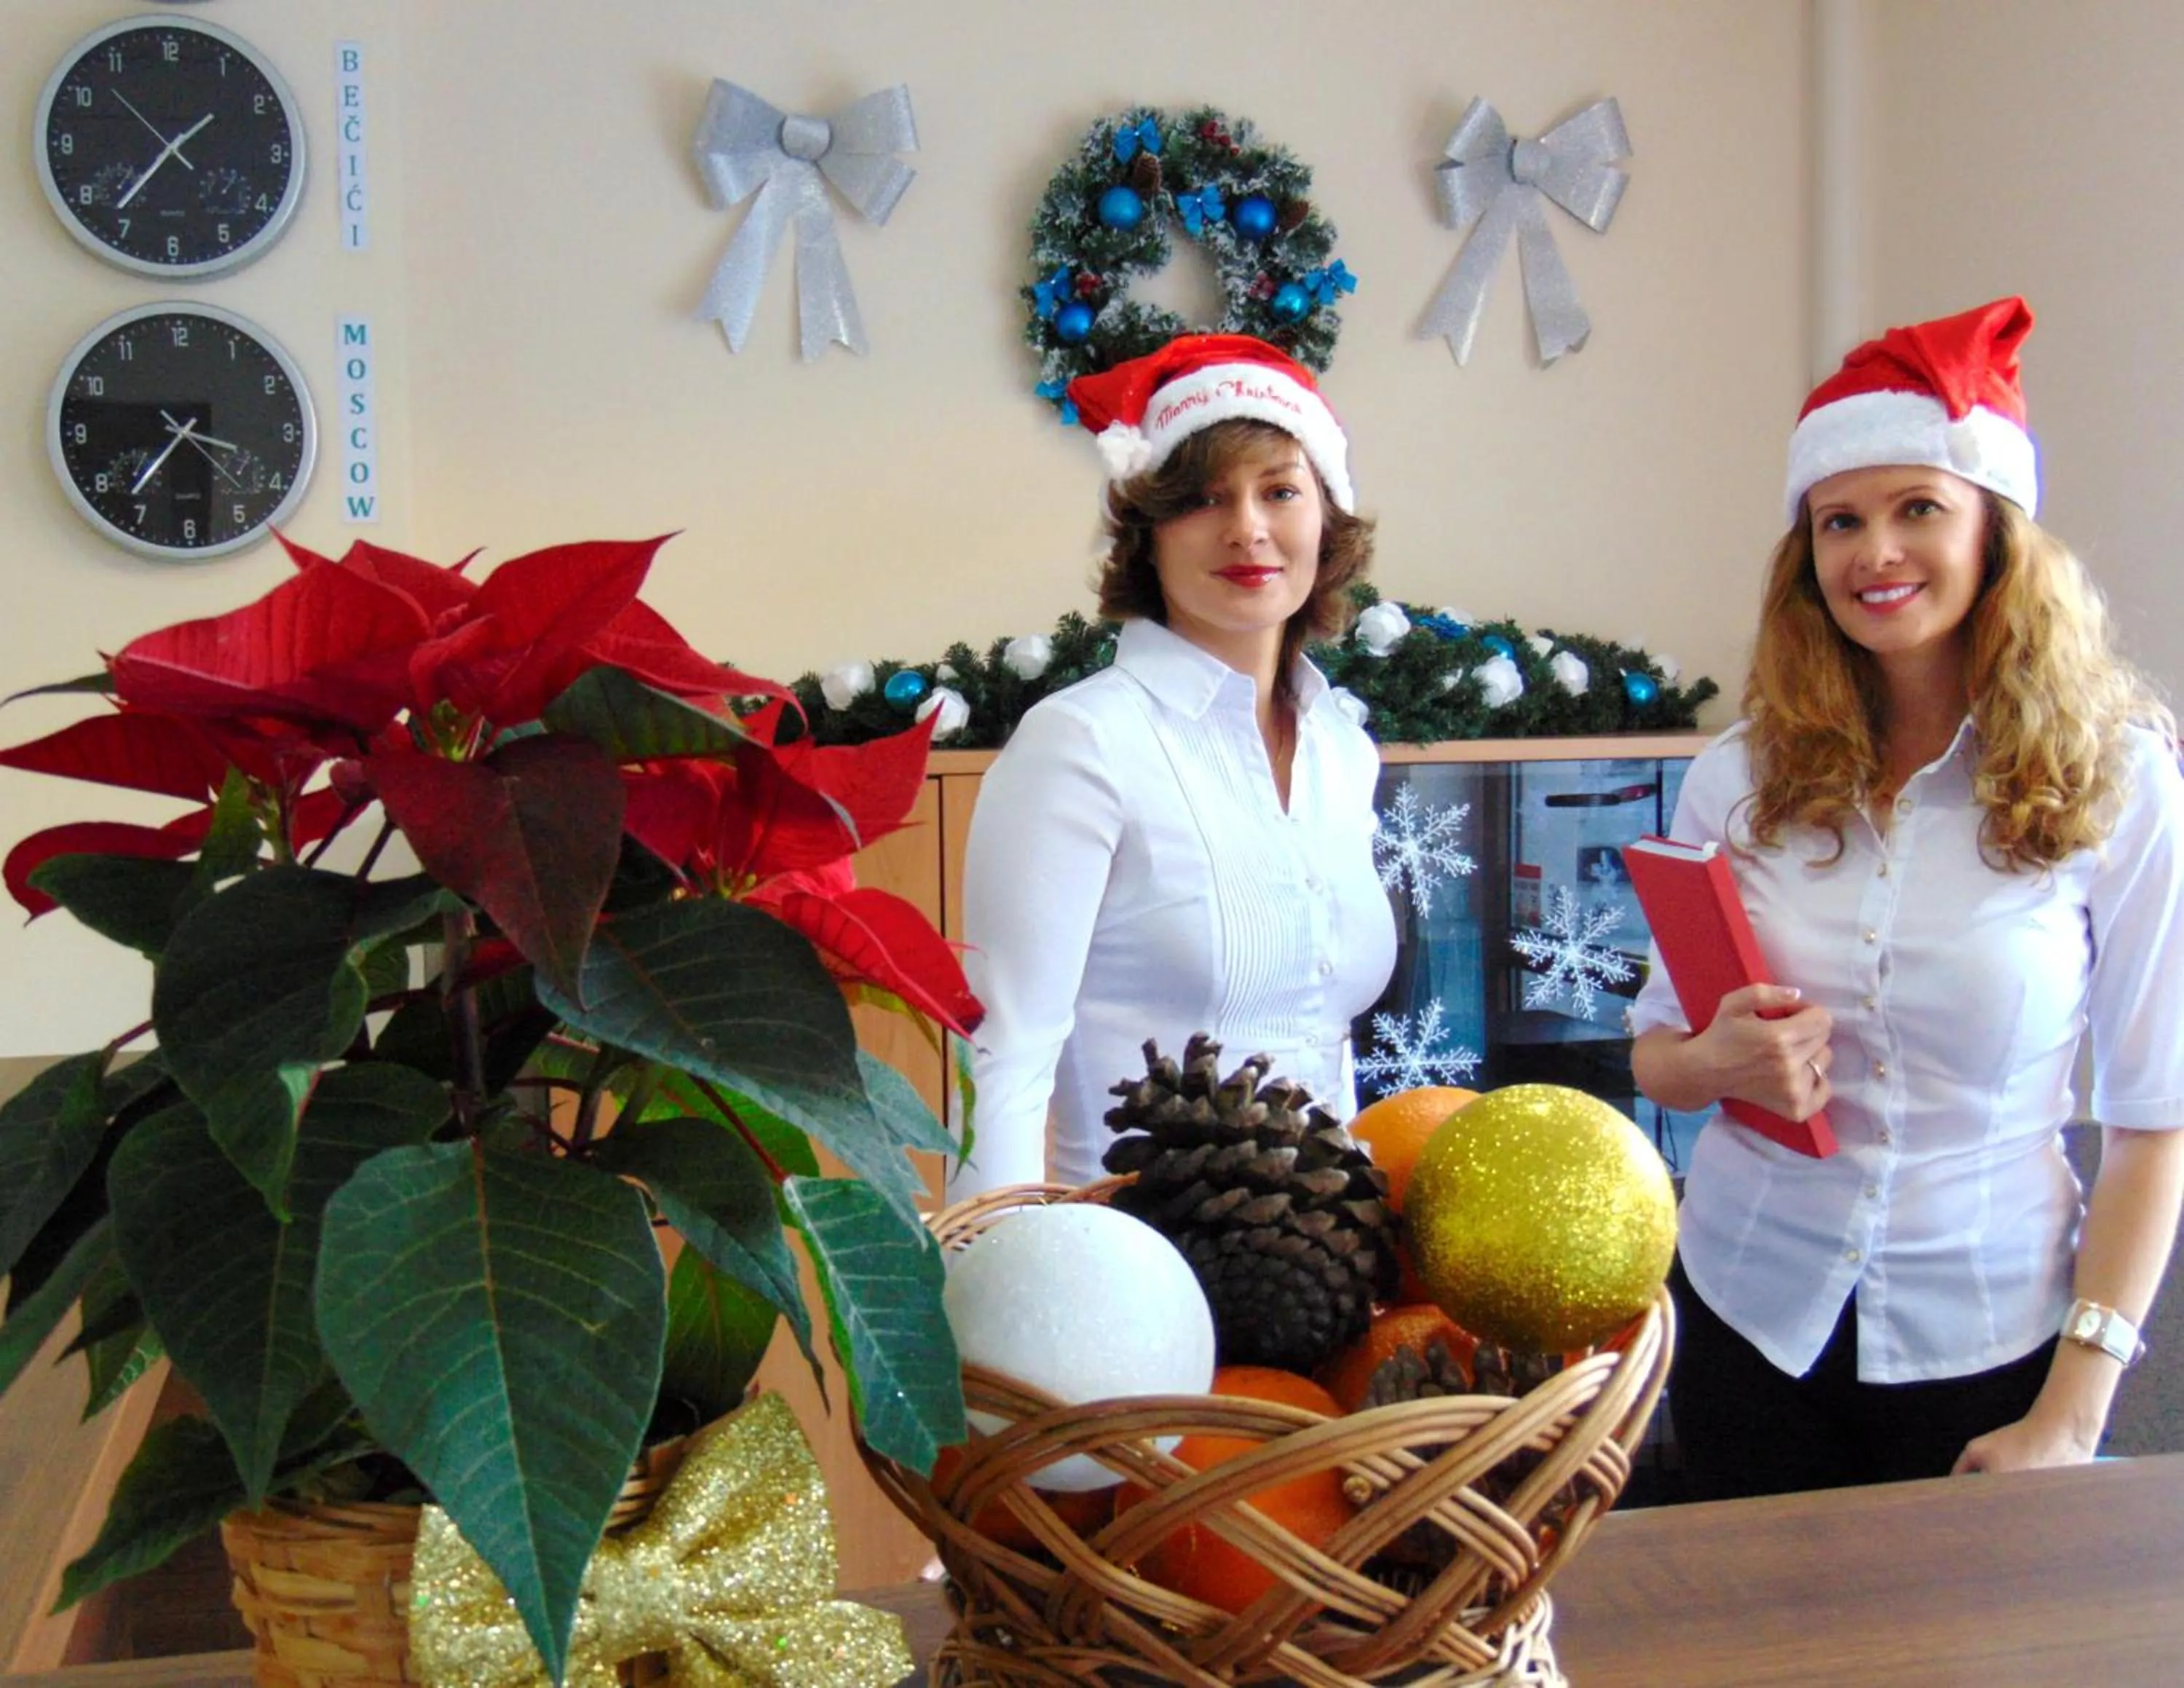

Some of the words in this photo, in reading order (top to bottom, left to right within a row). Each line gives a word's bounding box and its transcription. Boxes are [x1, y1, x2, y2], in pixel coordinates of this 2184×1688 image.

[162, 42, 178, 61] 12
[108, 52, 122, 73] 11
[76, 87, 92, 107] 10
[254, 95, 264, 114] 2
[61, 134, 72, 154] 9
[342, 50, 363, 246] BEČIĆI
[271, 144, 281, 164] 3
[80, 185, 92, 204] 8
[255, 194, 267, 211] 4
[118, 218, 130, 238] 7
[218, 224, 229, 242] 5
[167, 236, 178, 256] 6
[172, 327, 188, 347] 12
[119, 341, 132, 360] 11
[87, 376, 103, 395] 10
[265, 375, 274, 395] 2
[344, 324, 374, 518] MOSCOW
[75, 424, 86, 443] 9
[283, 423, 293, 442] 3
[96, 473, 108, 492] 8
[269, 473, 281, 490] 4
[134, 505, 146, 524] 7
[234, 505, 245, 523] 5
[184, 519, 195, 539] 6
